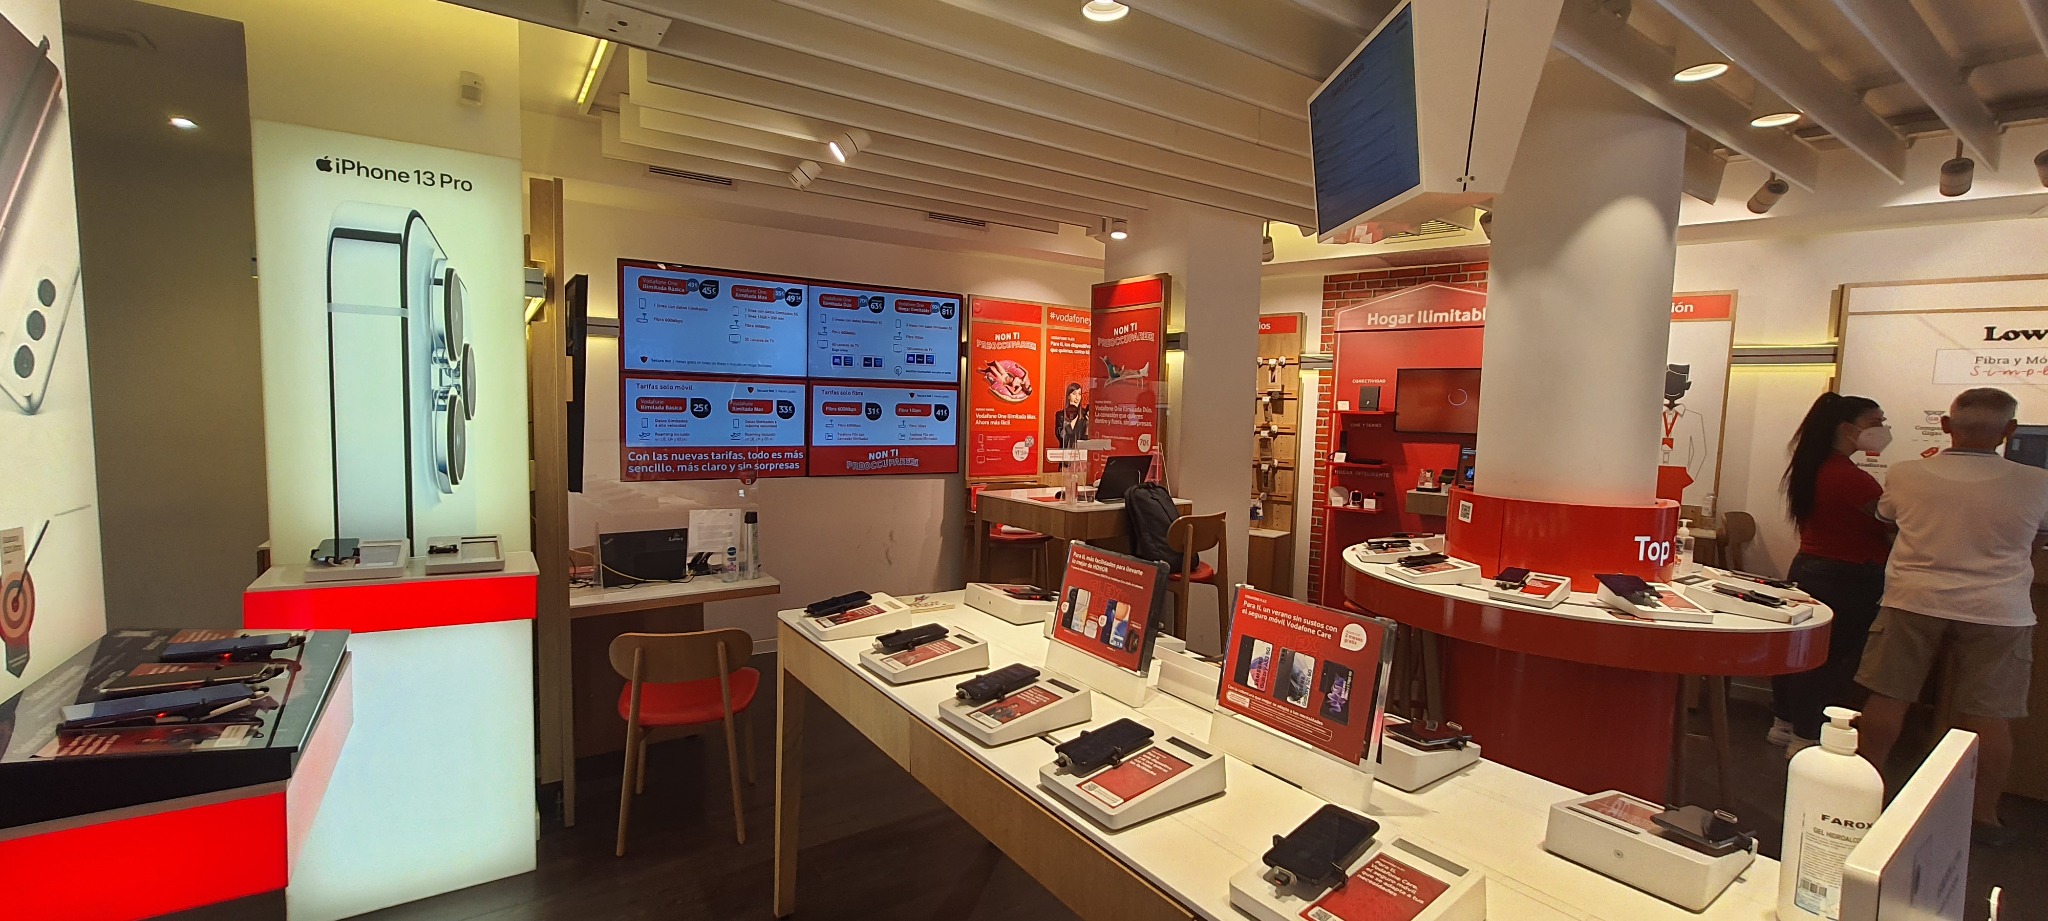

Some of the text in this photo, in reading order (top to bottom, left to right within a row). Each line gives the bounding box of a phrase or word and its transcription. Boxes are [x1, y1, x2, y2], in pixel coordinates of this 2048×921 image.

[335, 157, 473, 192] iPhone 13 Pro
[701, 287, 717, 295] 45€
[1367, 311, 1413, 328] Hogar
[1113, 321, 1138, 336] NON TI
[995, 331, 1020, 341] NON TI
[1974, 356, 2010, 365] Fibra
[2013, 357, 2022, 366] y
[636, 382, 659, 390] Tarifas
[693, 403, 709, 412] 25€
[778, 405, 793, 413] 33€
[867, 407, 880, 415] 31€
[627, 450, 804, 462] Con las nuevas tarifas, todo es más
[868, 448, 899, 460] NON TI
[627, 461, 800, 474] sencillo, más claro y sin sorpresas
[1073, 551, 1082, 559] Para
[1634, 536, 1671, 567] Top
[1243, 600, 1256, 610] Para
[1262, 606, 1271, 614] un
[1271, 609, 1292, 620] verano
[1292, 614, 1302, 622] sin
[1303, 618, 1325, 629] sustos
[1325, 624, 1338, 633] con
[1248, 610, 1268, 620] seguro
[1268, 615, 1286, 626] móvil
[1286, 620, 1316, 635] Vodafone
[1316, 629, 1332, 640] Care
[1812, 826, 1825, 836] GEL
[1374, 860, 1390, 870] Para
[1370, 862, 1401, 881] Vodafone
[1373, 871, 1397, 884] seguro
[1356, 873, 1398, 897] necesidades
[1361, 870, 1375, 879] que
[1382, 881, 1407, 895] adapta
